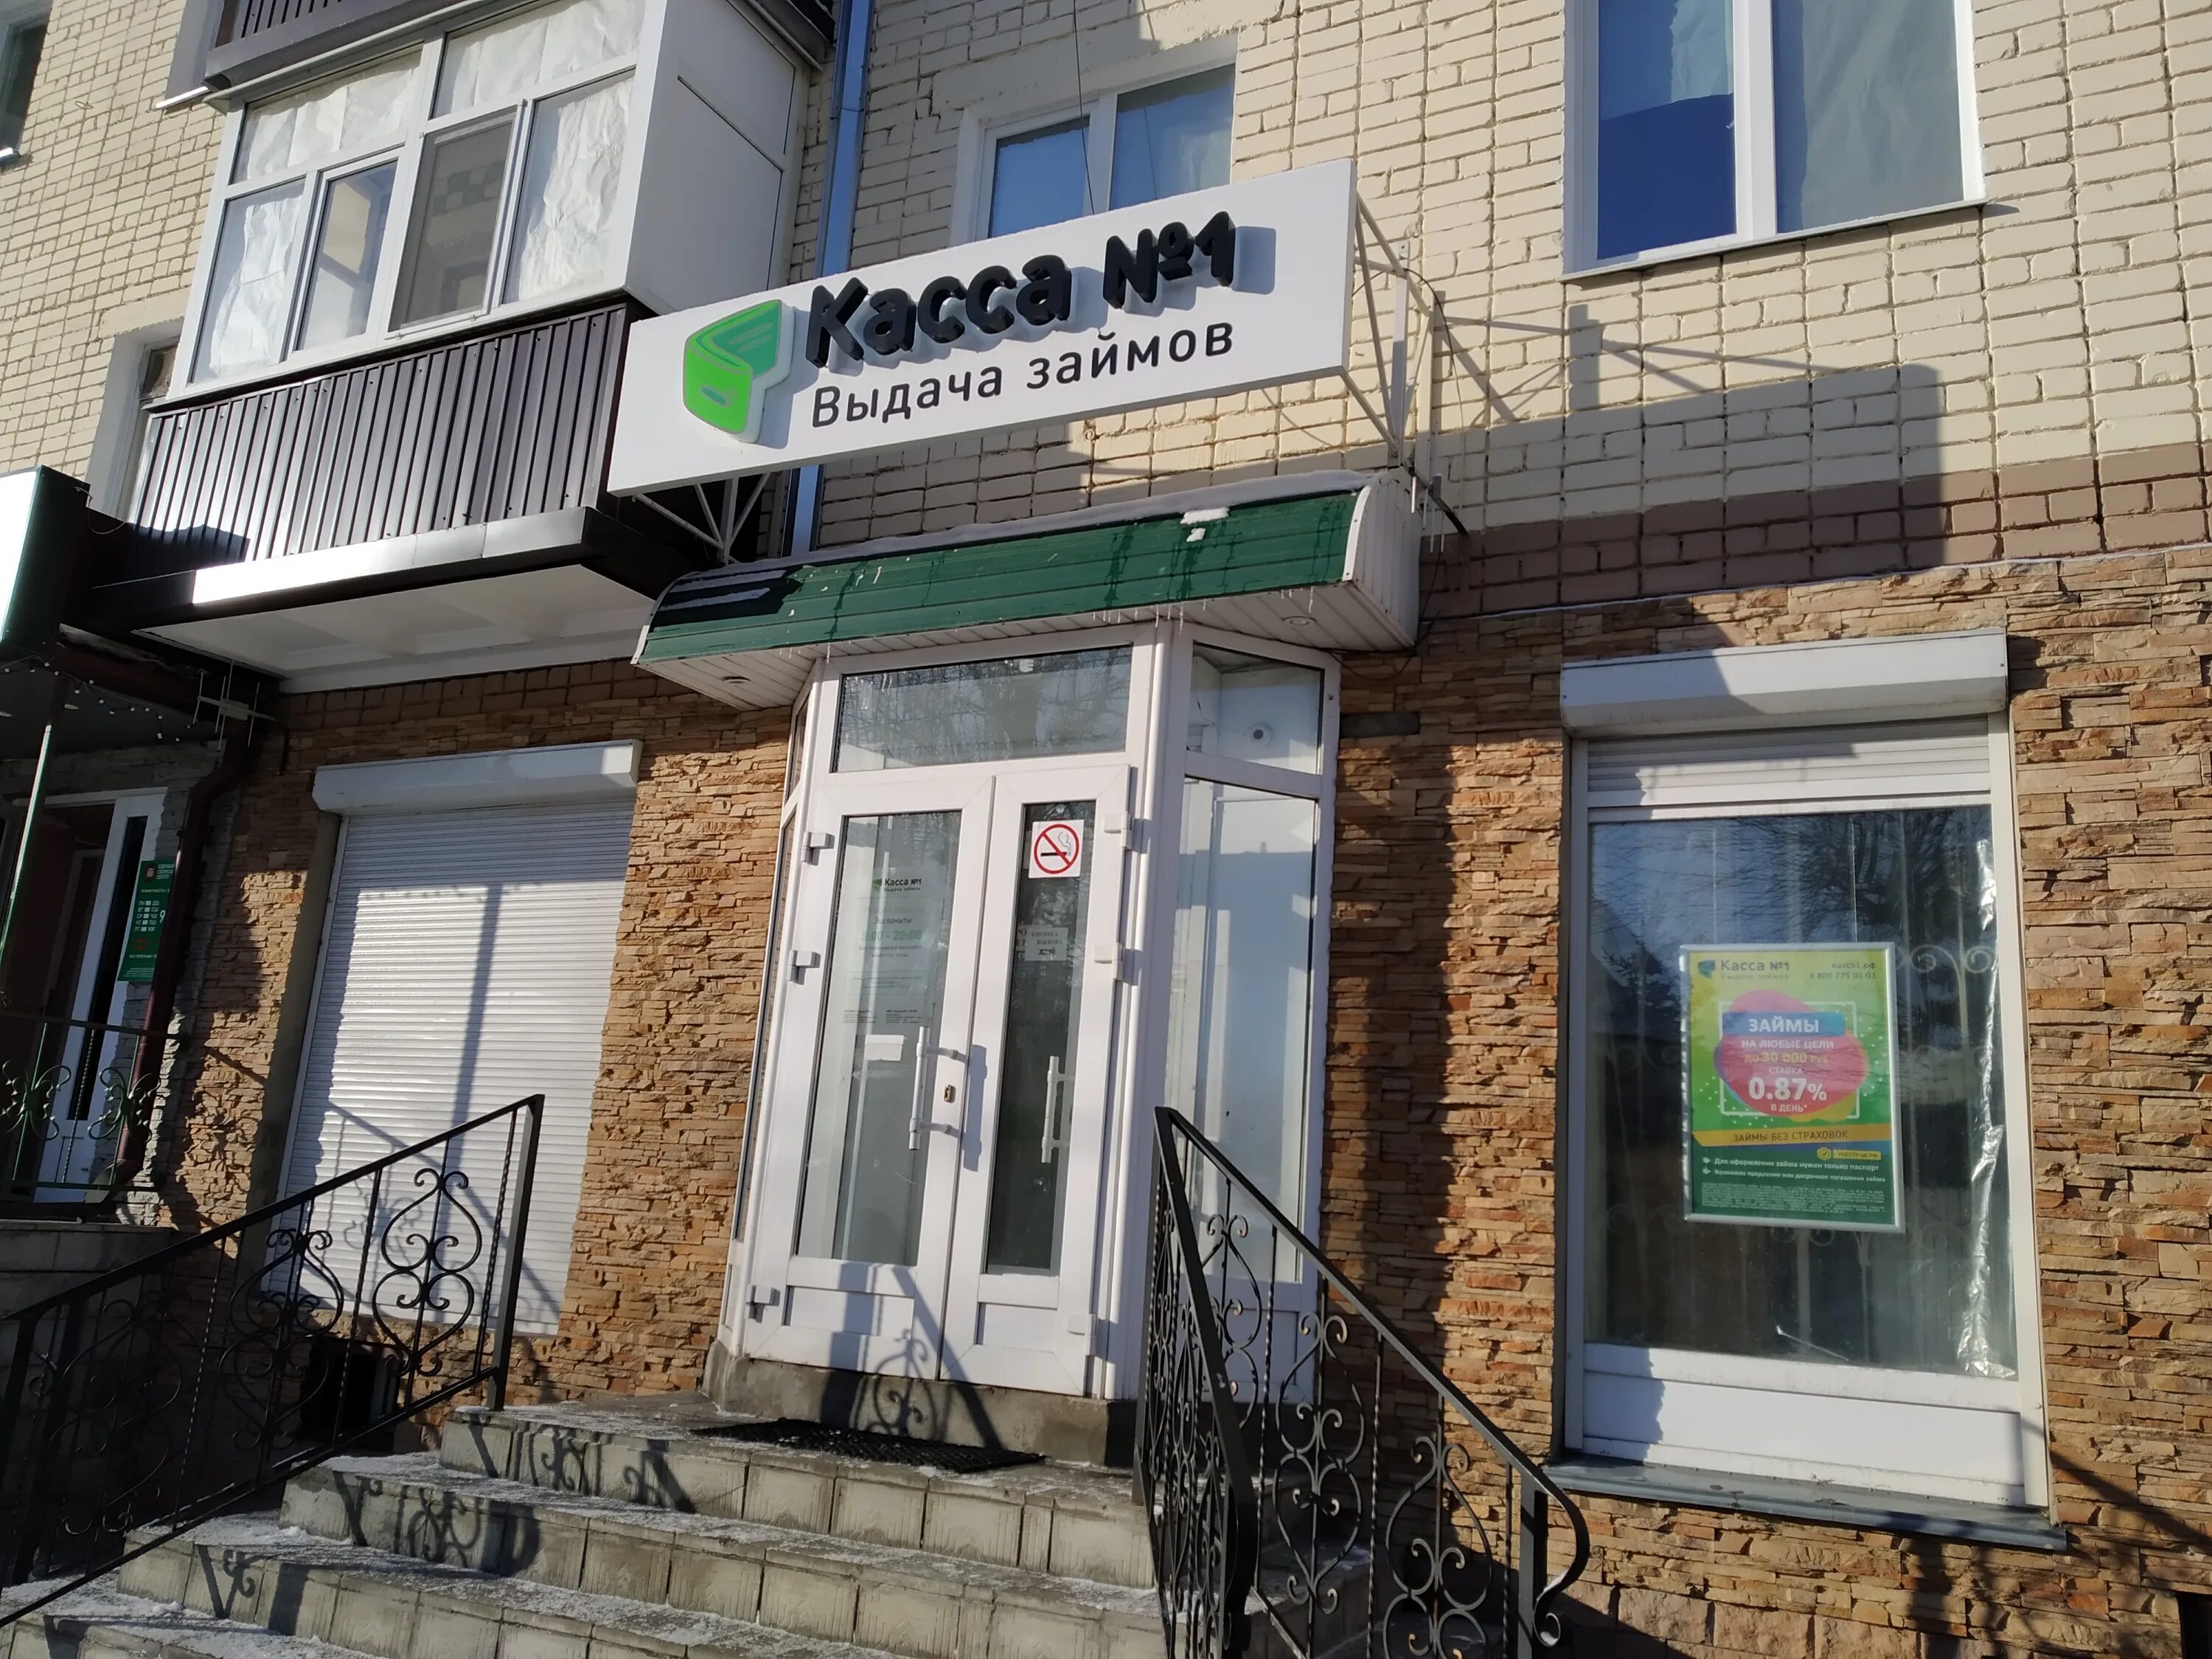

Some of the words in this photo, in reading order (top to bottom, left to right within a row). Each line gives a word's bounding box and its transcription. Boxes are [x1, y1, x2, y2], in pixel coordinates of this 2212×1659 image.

[805, 254, 1072, 368] Касса
[1102, 211, 1236, 310] №1
[812, 366, 1002, 428] Выдача
[1026, 321, 1233, 389] займов
[884, 877, 908, 886] Касса
[893, 929, 922, 941] 20:00
[1720, 959, 1765, 971] Касса
[1770, 961, 1790, 971] №1
[1748, 1015, 1820, 1033] ЗАЙМЫ
[1742, 1040, 1756, 1048] НА
[1759, 1040, 1801, 1048] ЛЮБЫЕ
[1804, 1040, 1834, 1050] ЦЕЛИ
[1761, 1051, 1778, 1062] 30
[1769, 1066, 1804, 1074] СТАВКА
[1748, 1077, 1827, 1102] 0.87%
[1733, 1132, 1768, 1142] ЗАЙМЫ
[1771, 1133, 1788, 1141] БЕЗ
[1792, 1130, 1848, 1140] СТРАХОВОК
[1850, 1164, 1879, 1172] паспорт
